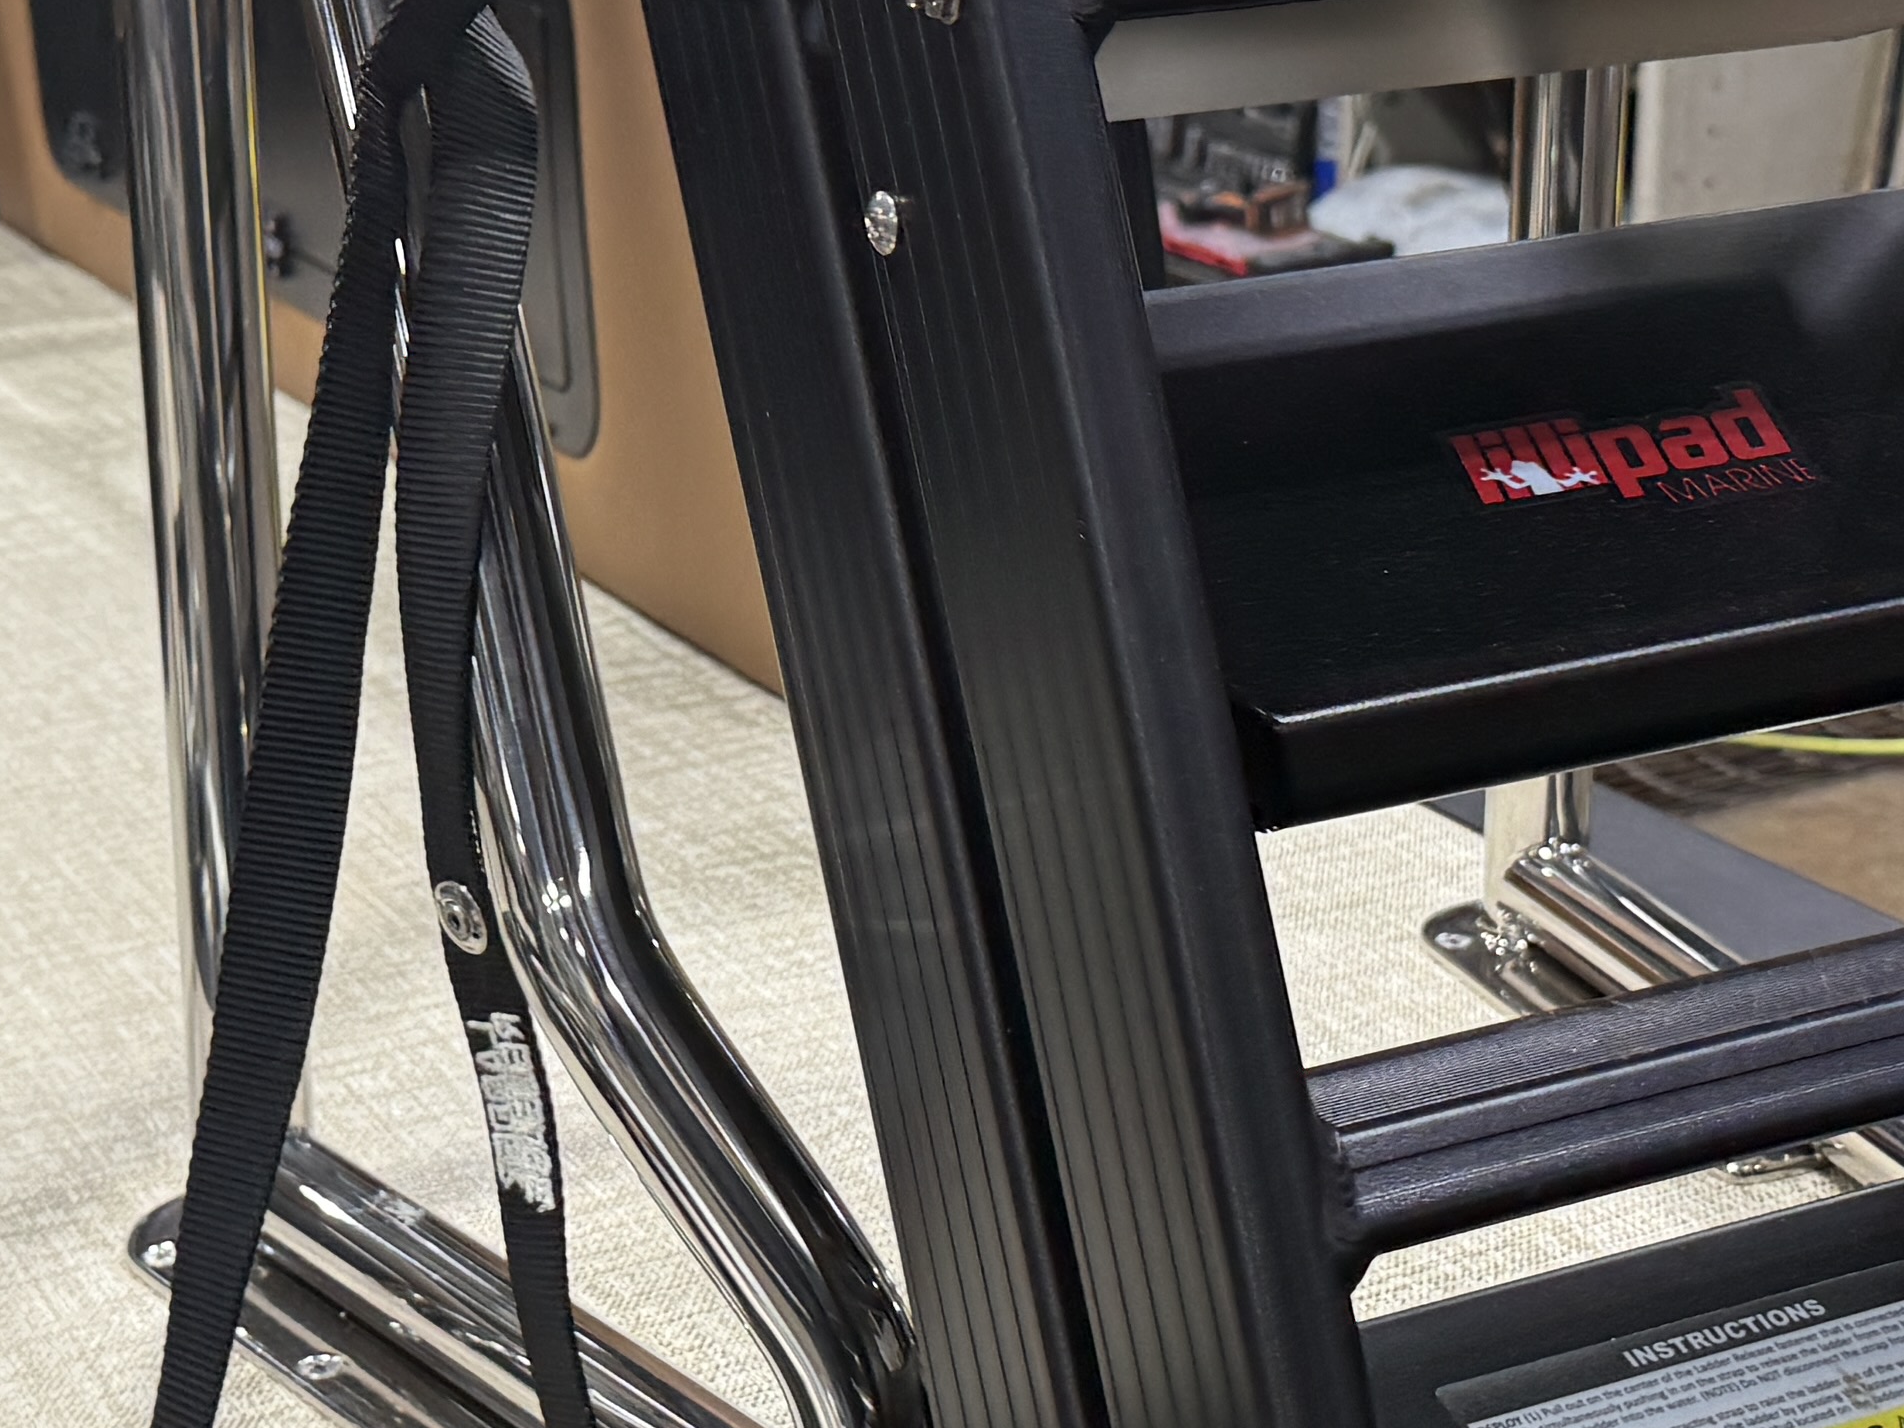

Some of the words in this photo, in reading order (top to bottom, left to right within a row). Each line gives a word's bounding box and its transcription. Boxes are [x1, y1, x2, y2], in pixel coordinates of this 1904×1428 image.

[1449, 388, 1793, 504] lillipad
[1658, 458, 1816, 503] MARINE
[1623, 1299, 1825, 1367] INSTRUCTIONS
[1522, 1410, 1543, 1424] (1)
